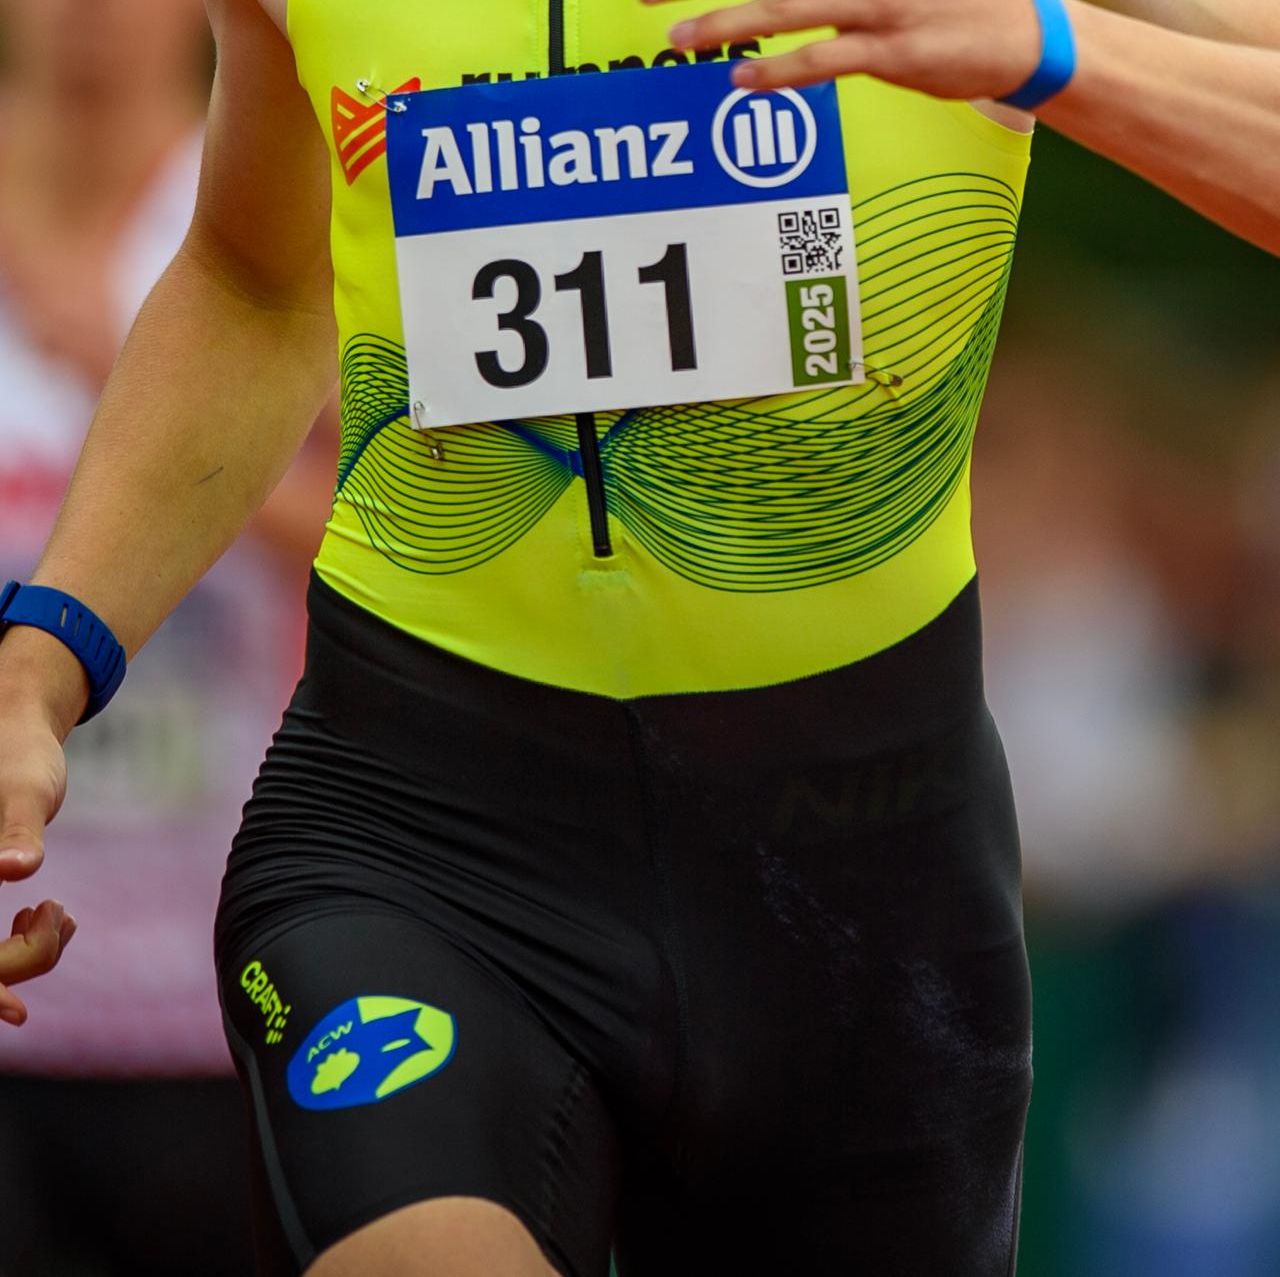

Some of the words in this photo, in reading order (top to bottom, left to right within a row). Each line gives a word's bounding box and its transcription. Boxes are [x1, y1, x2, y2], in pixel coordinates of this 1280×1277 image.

[416, 116, 695, 200] Allianz
[472, 242, 698, 390] 311
[800, 283, 839, 378] 2025
[240, 961, 283, 1028] CRAFT
